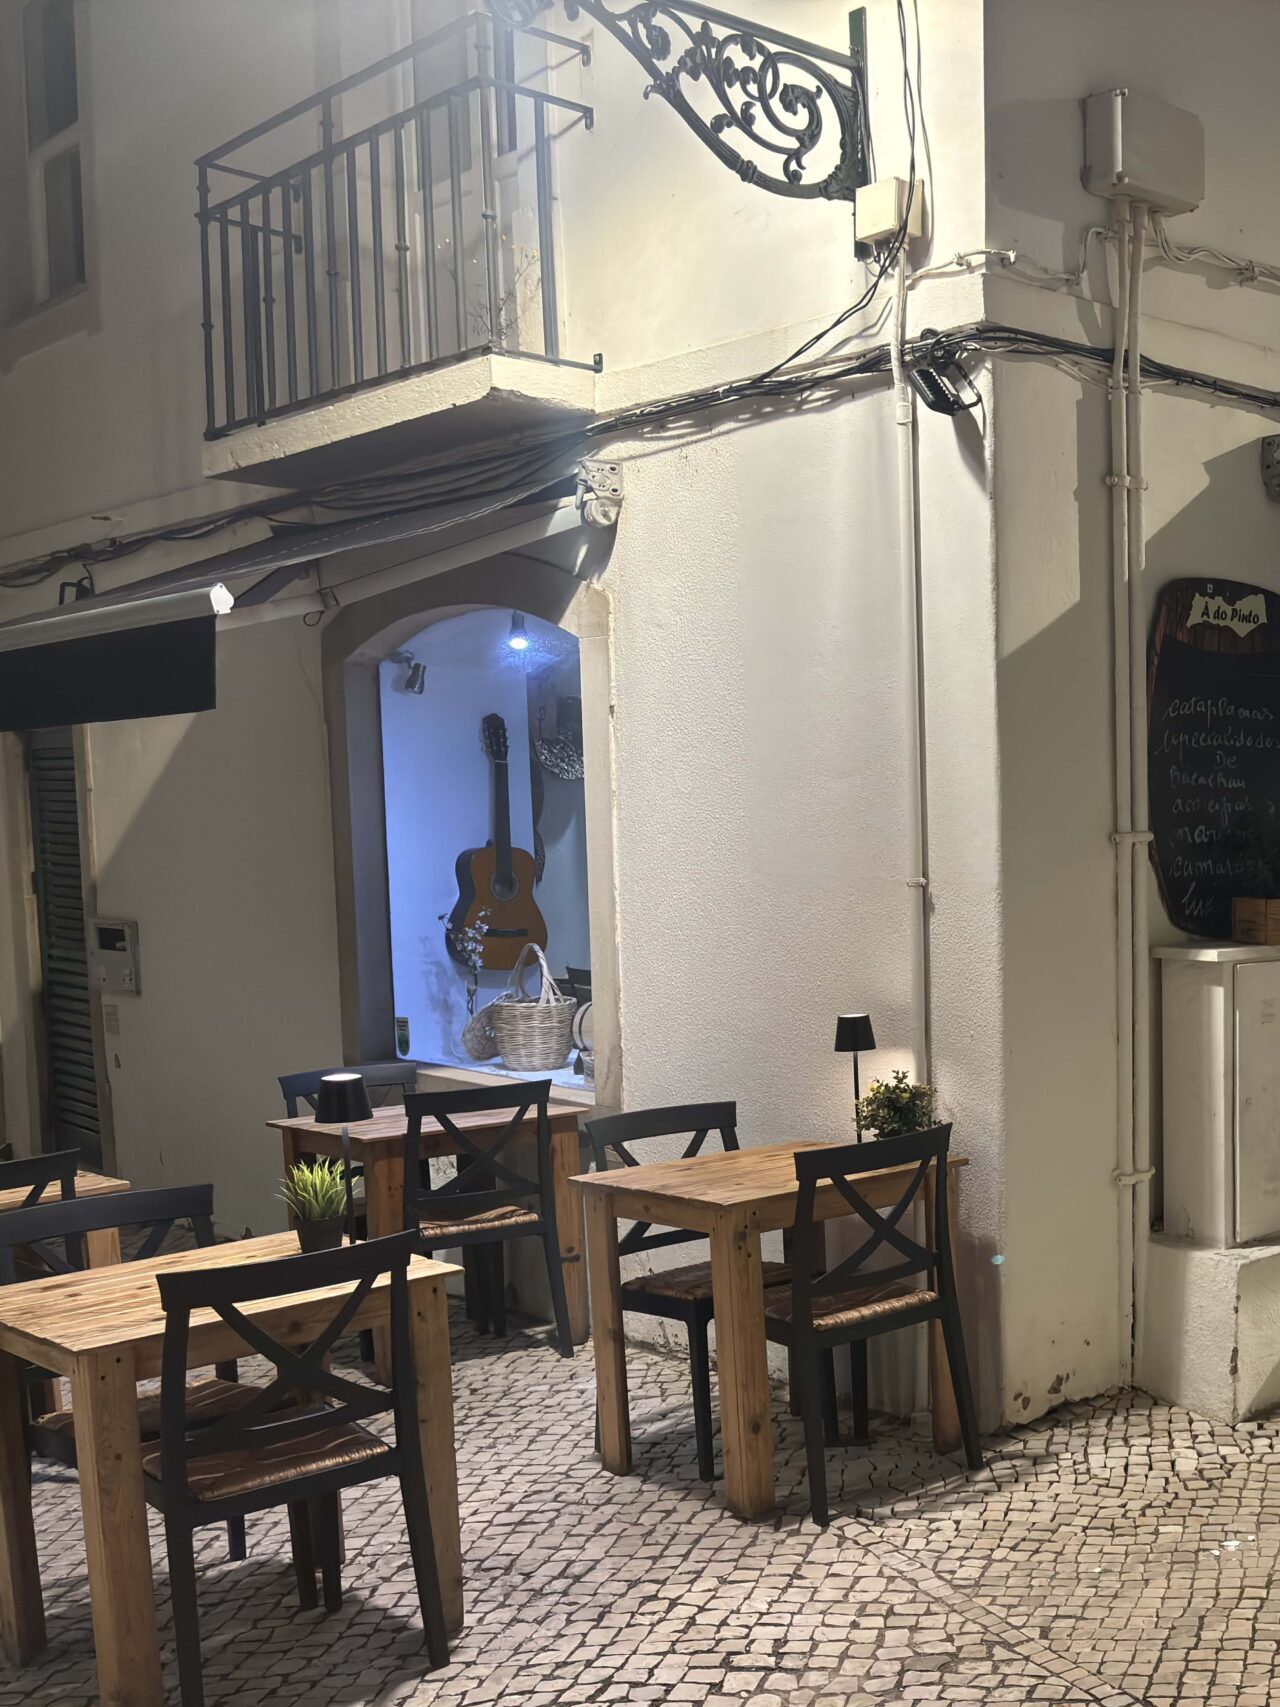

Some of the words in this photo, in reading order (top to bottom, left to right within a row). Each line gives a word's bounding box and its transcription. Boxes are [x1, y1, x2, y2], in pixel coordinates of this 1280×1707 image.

[1213, 604, 1227, 620] do
[1230, 607, 1259, 624] Pinto
[1213, 750, 1238, 768] De
